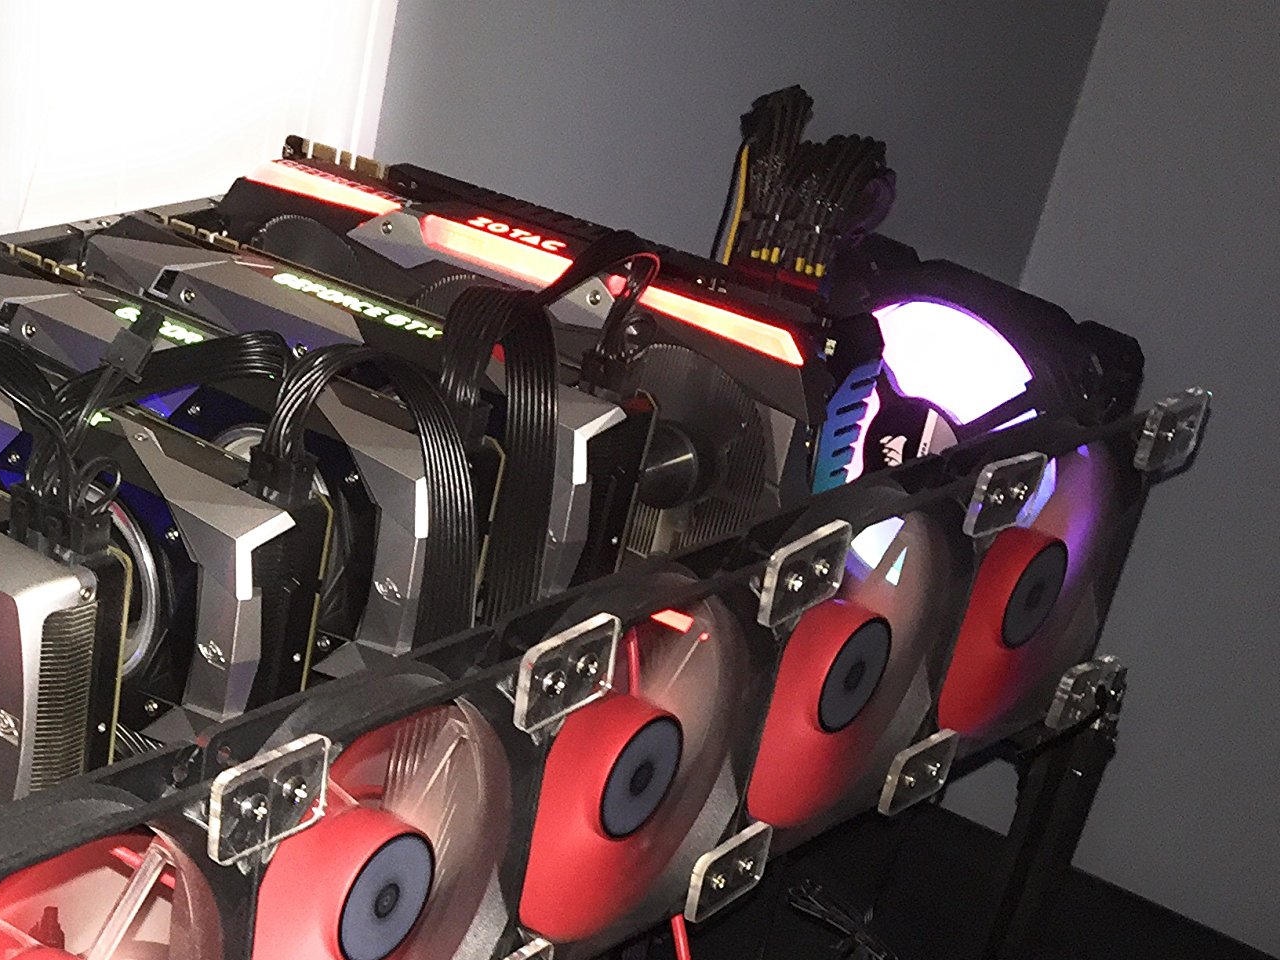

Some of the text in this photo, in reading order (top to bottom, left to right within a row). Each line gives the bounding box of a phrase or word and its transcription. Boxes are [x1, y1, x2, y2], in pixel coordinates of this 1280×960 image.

[466, 216, 567, 251] ZOTAC
[272, 272, 443, 338] GEFORCE GTX
